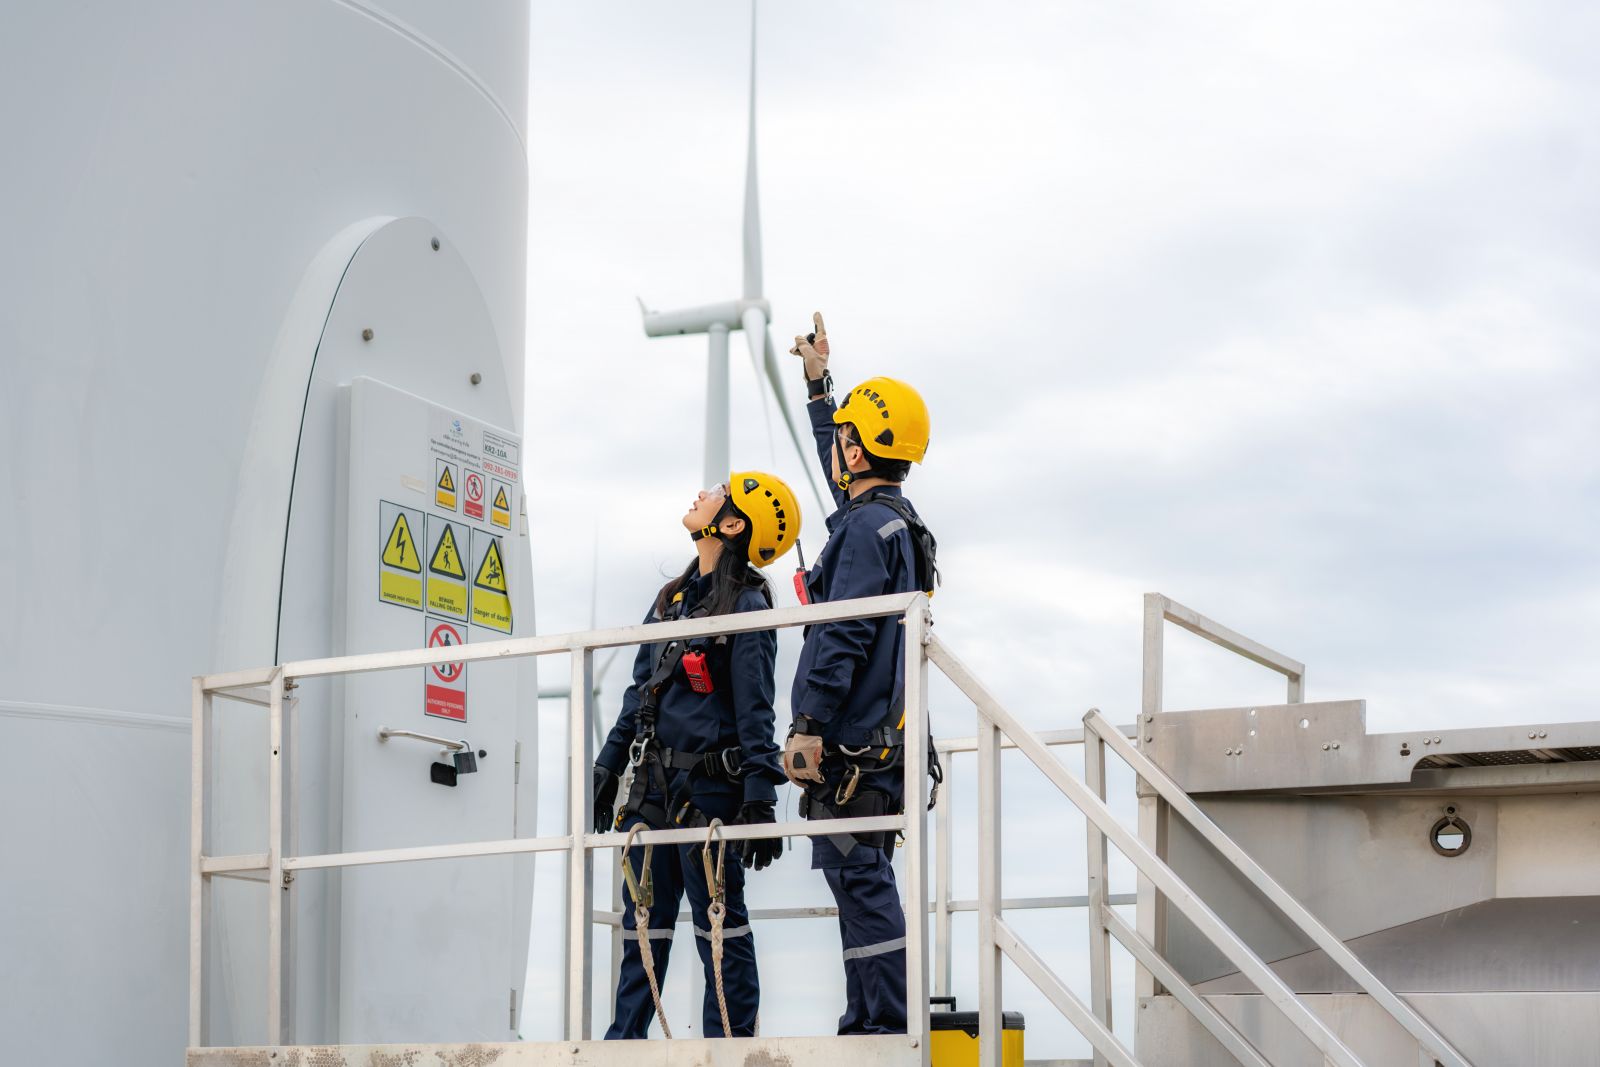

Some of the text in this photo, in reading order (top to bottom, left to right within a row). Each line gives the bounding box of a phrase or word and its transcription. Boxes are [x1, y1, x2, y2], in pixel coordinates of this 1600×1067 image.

[384, 592, 396, 600] DANGER
[406, 596, 419, 605] VOLTAGE
[438, 596, 454, 605] BEWARE
[430, 601, 463, 614] FALLING OBJECTS
[474, 607, 510, 622] Danger of death
